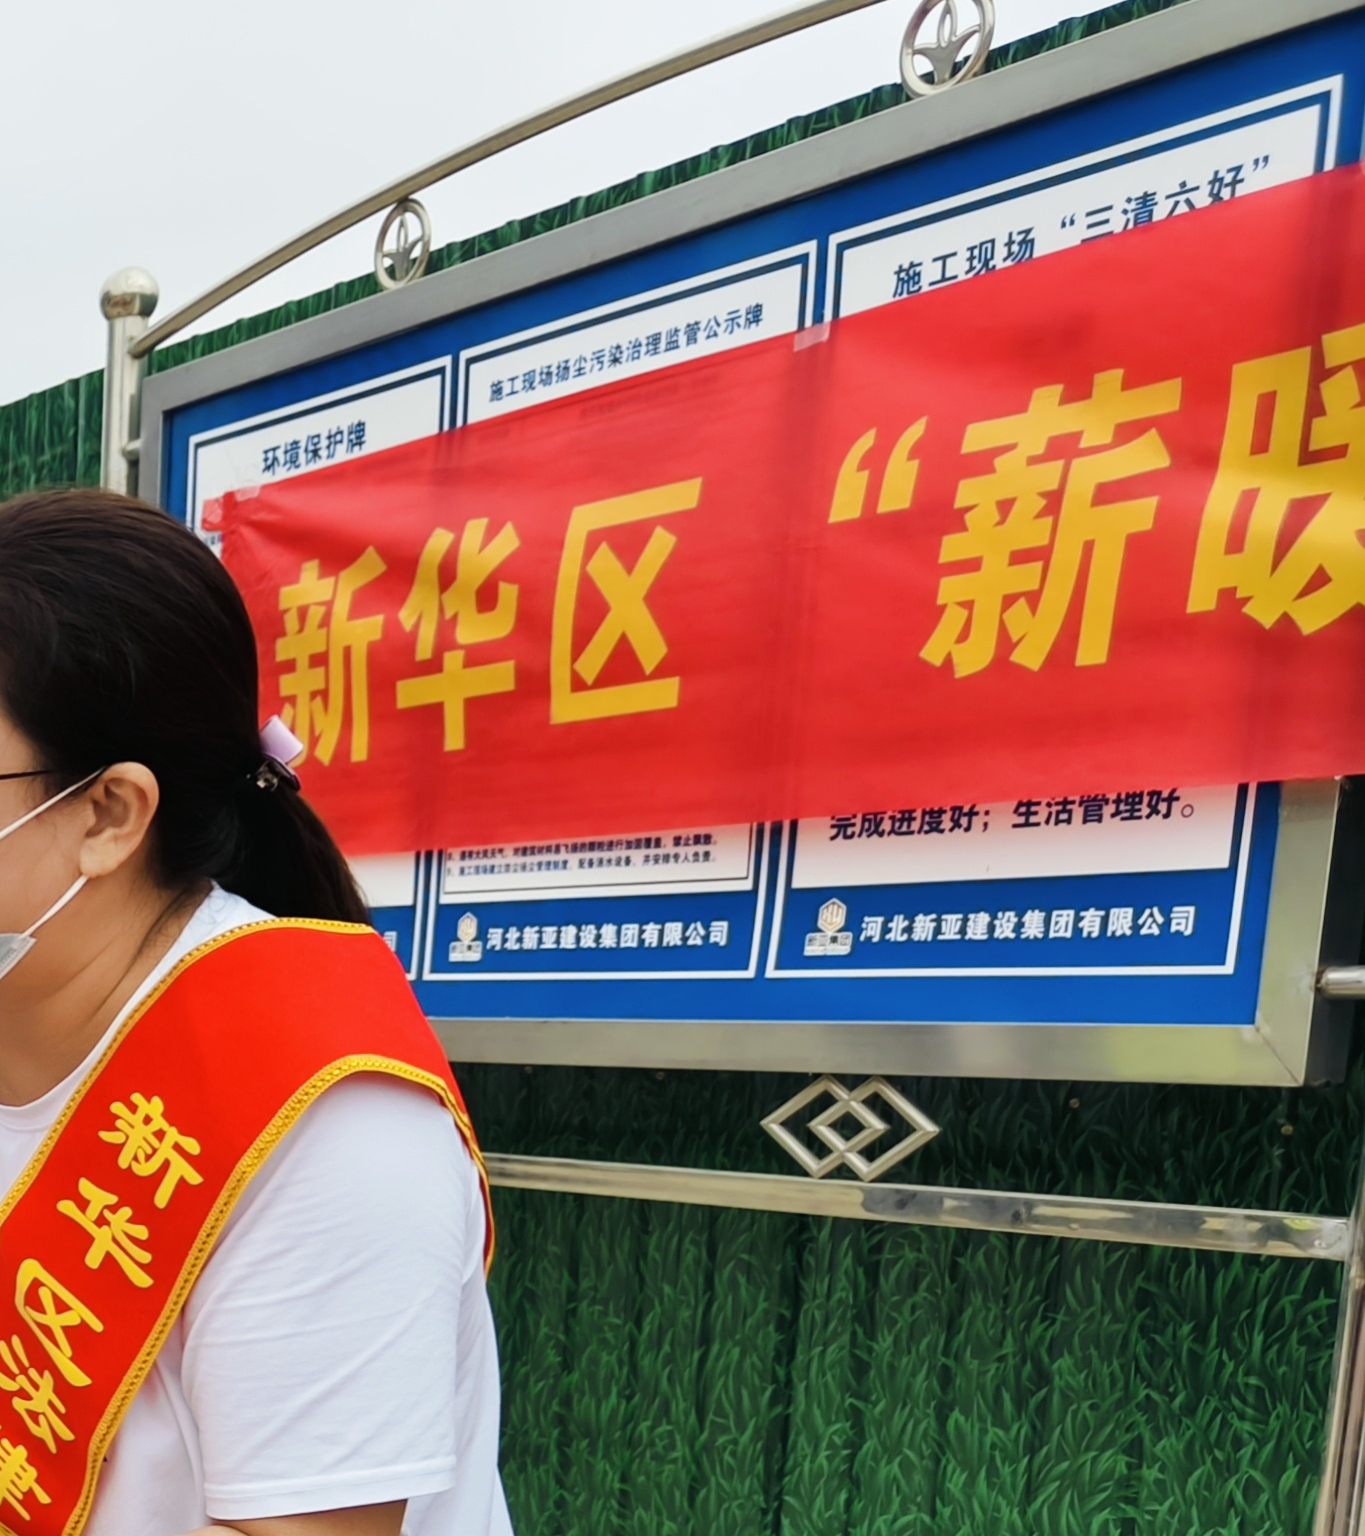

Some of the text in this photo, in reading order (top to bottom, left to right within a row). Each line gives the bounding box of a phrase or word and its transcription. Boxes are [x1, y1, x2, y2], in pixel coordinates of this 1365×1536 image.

[488, 302, 764, 403] 施工现场扬尘污染治理监管公示牌
[260, 420, 367, 476] 环境保护牌
[486, 920, 730, 951] 河北新亚建设集团有限公司
[860, 905, 1197, 943] 河北新亚建设集团有限公司
